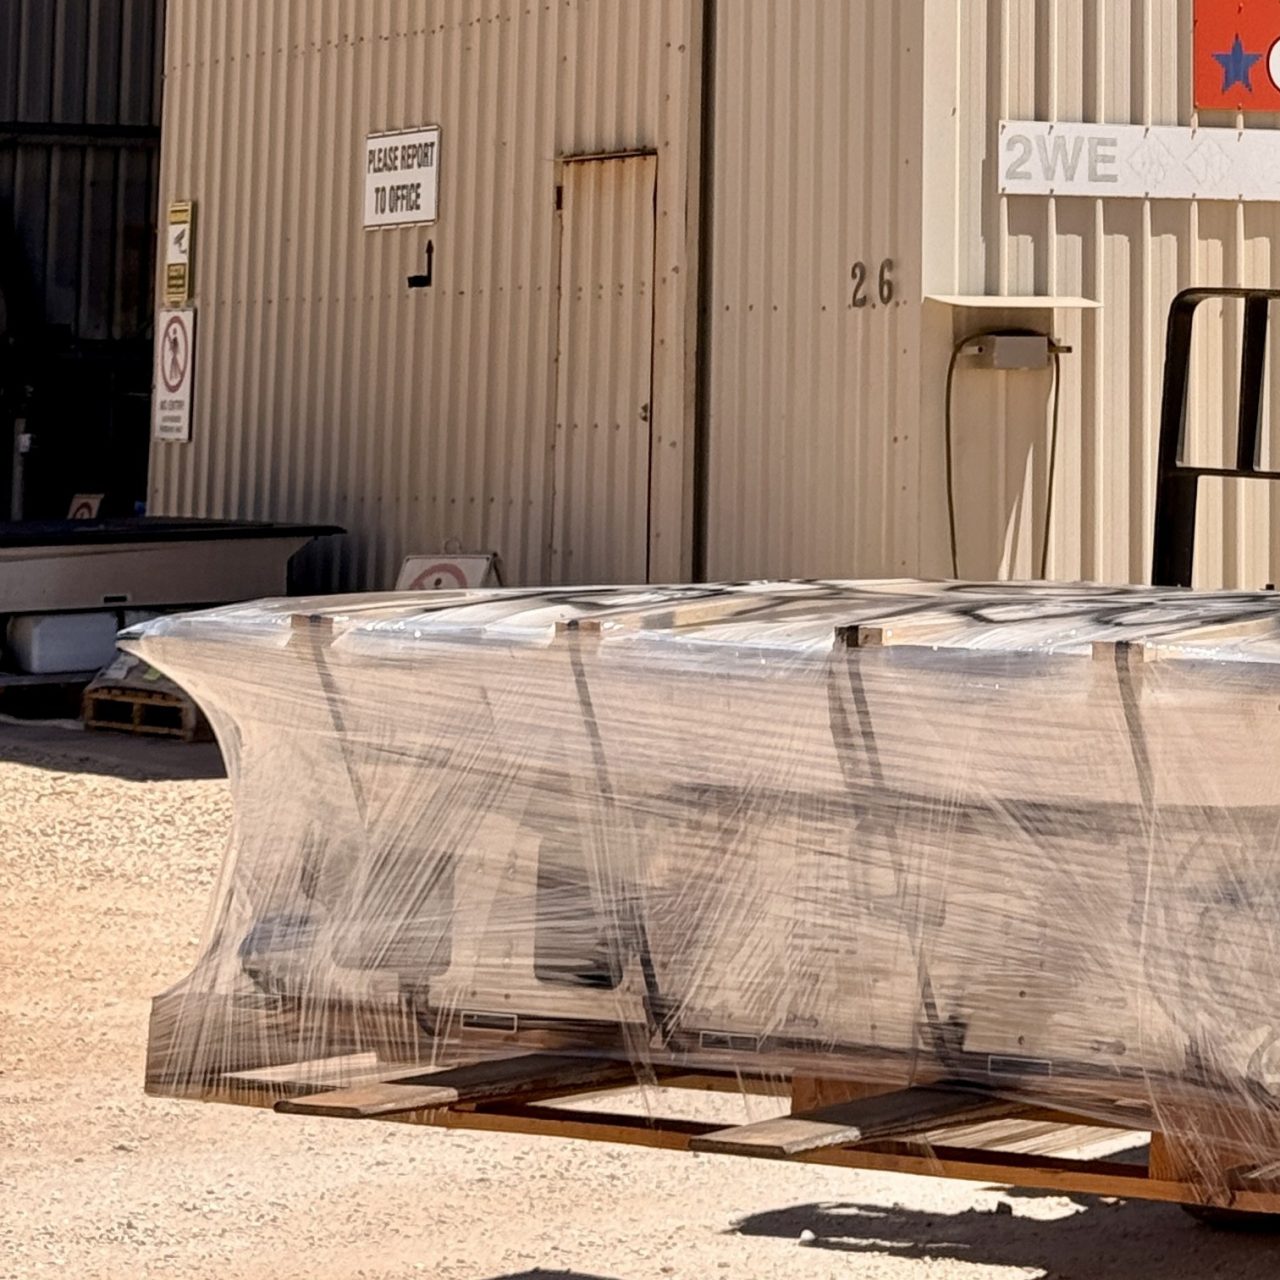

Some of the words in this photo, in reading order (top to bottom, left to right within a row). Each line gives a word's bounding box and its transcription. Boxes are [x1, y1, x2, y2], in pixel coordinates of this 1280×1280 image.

[367, 145, 399, 173] PLEASE
[400, 141, 436, 171] REPORT
[1004, 124, 1119, 183] 2WE
[374, 185, 386, 215] TO
[388, 182, 421, 213] OFFICE
